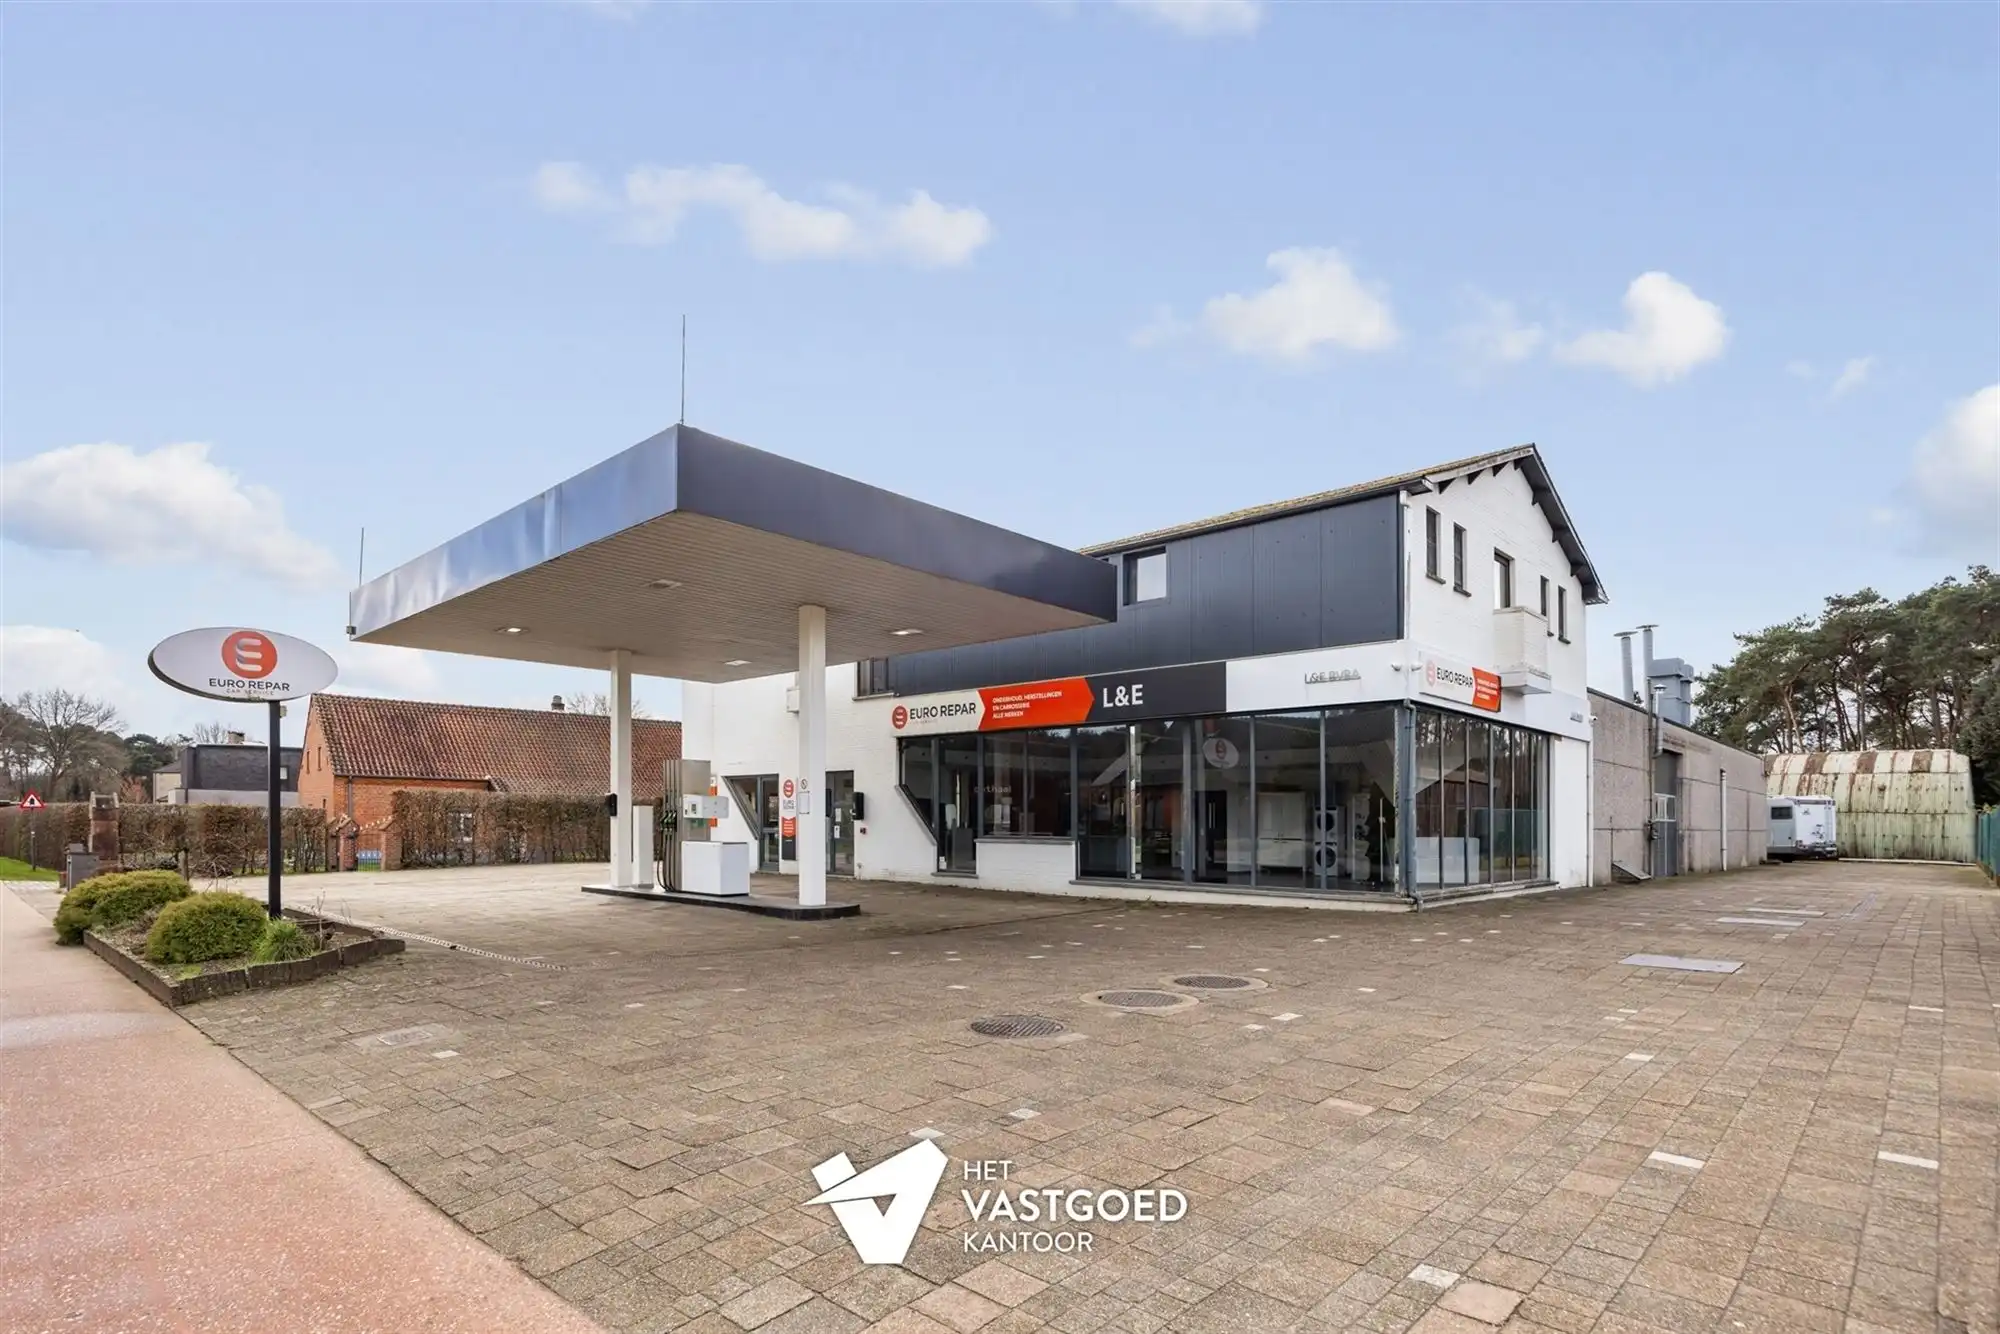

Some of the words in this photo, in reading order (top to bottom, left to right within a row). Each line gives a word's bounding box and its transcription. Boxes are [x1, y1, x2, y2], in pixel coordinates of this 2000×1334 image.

[209, 678, 245, 689] EURO
[248, 680, 290, 691] REPAR
[1436, 667, 1454, 683] EURO
[1454, 672, 1473, 688] REPAR
[1103, 684, 1144, 708] L&E
[910, 706, 938, 719] EURO
[940, 702, 976, 717] REPAR
